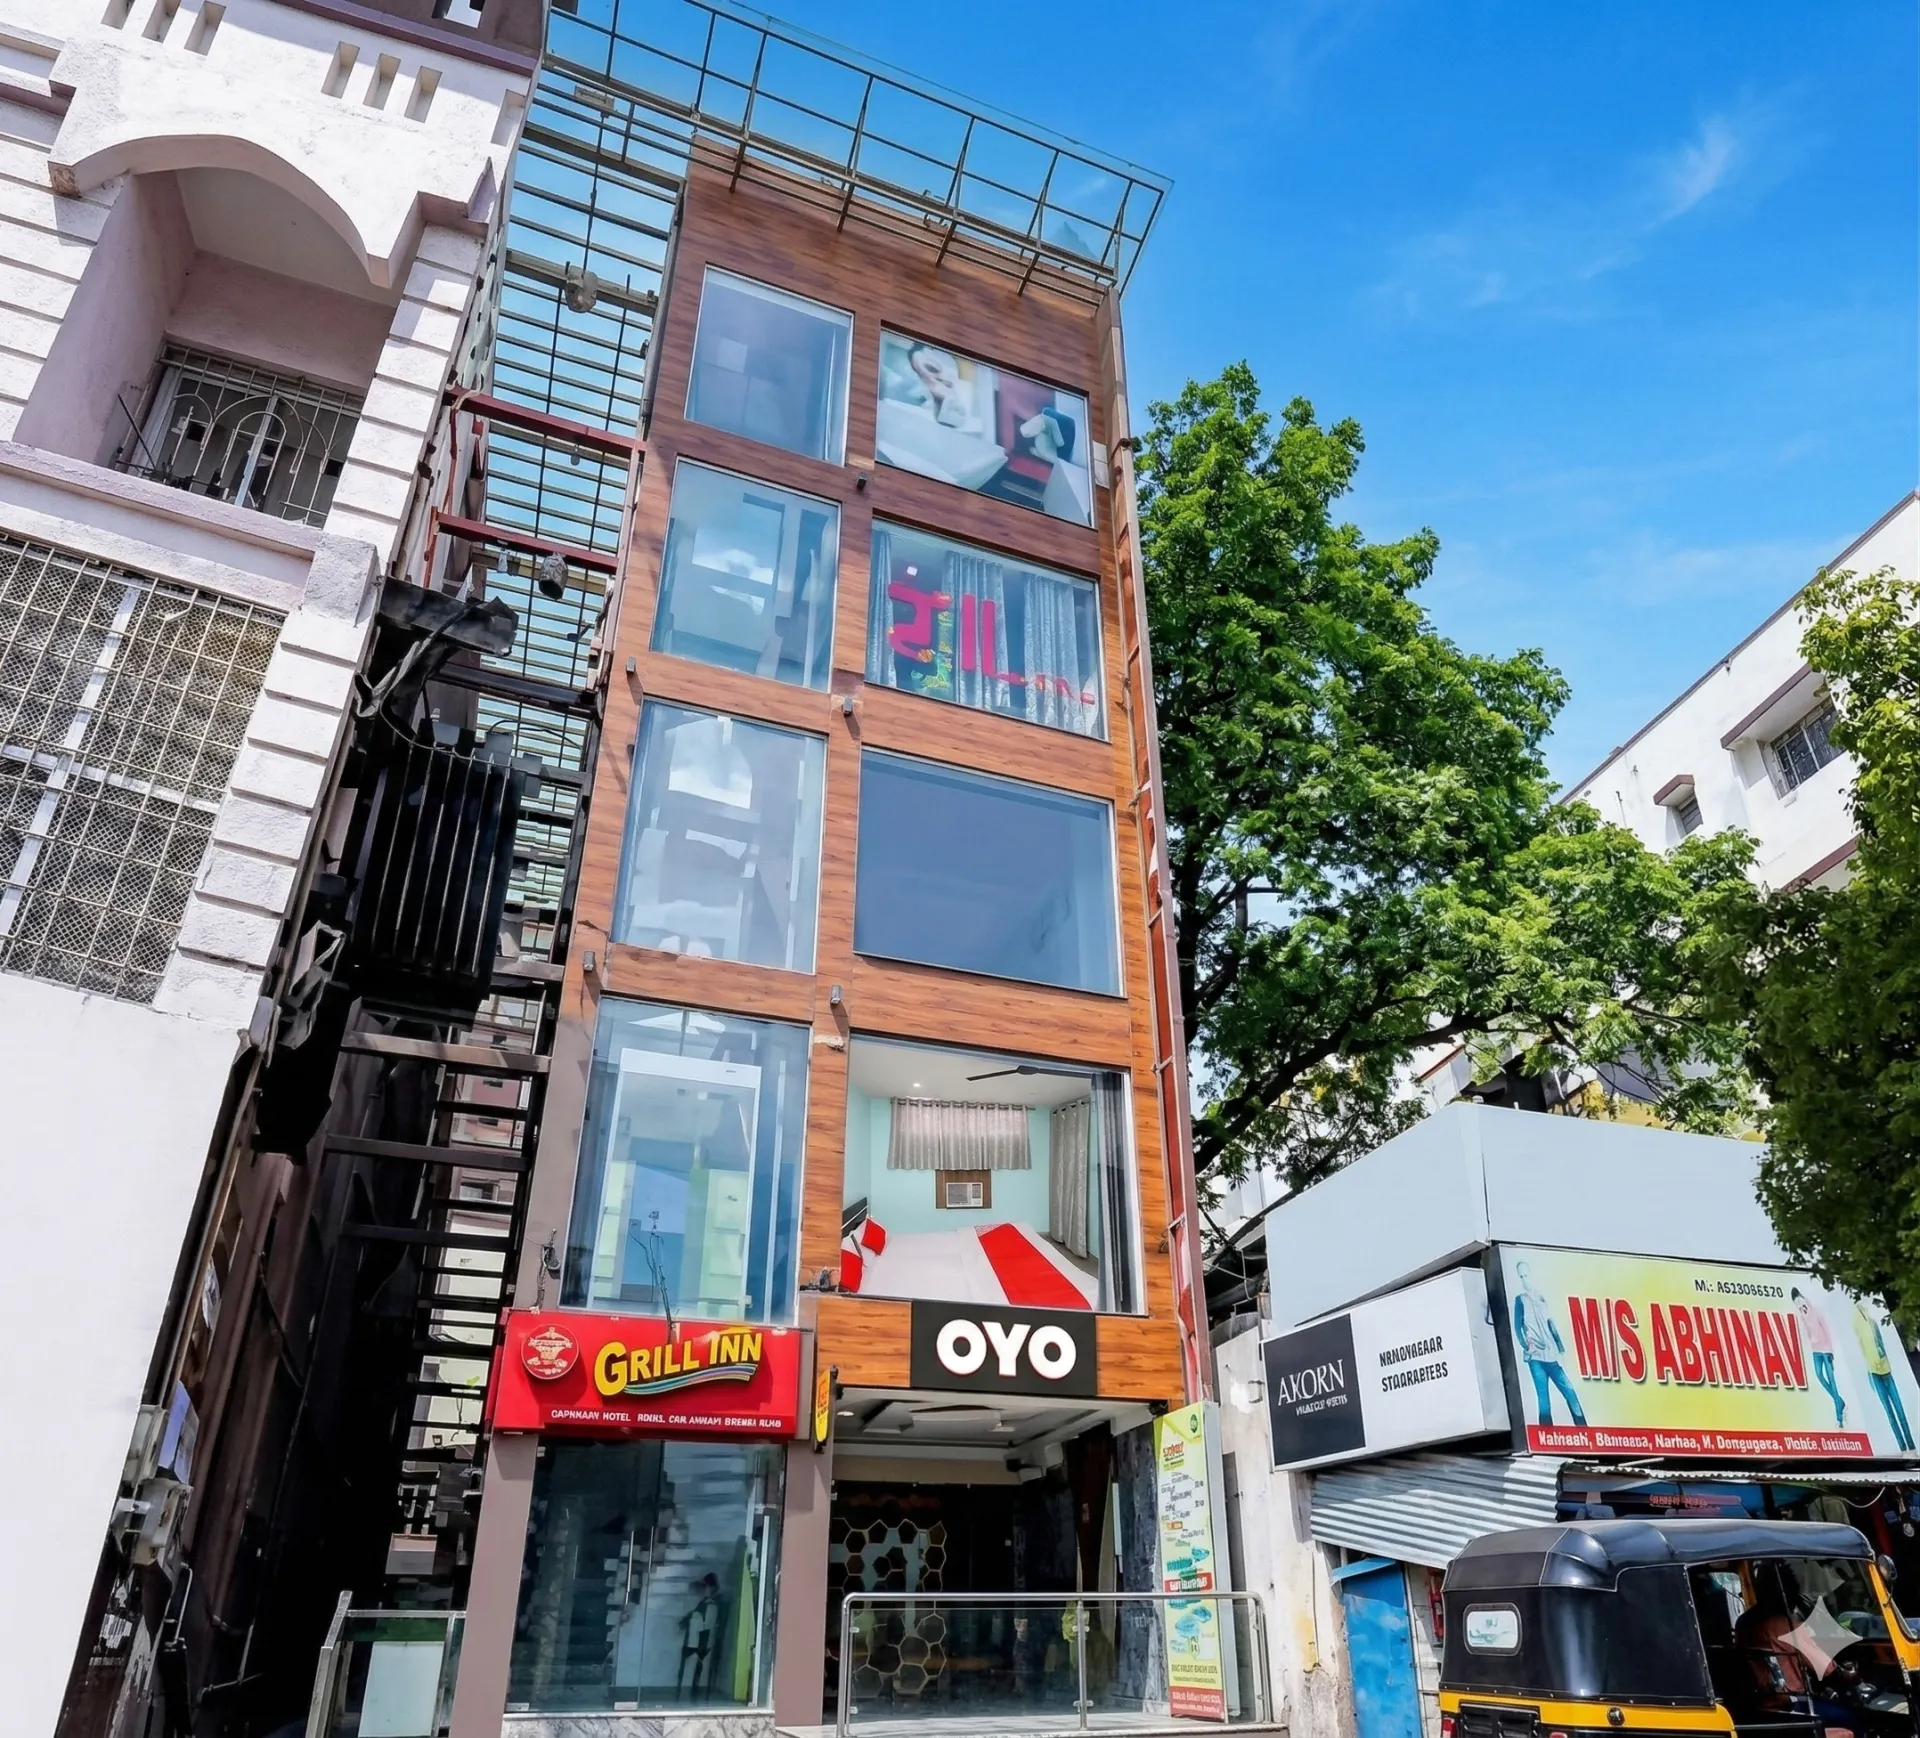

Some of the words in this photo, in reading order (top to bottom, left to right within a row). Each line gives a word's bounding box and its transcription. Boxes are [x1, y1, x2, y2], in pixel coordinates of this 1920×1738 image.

[594, 1340, 700, 1396] GRILL
[709, 1332, 762, 1365] INN
[936, 1318, 1077, 1381] OYO
[1648, 1302, 1809, 1390] ABHINAV
[1277, 1358, 1345, 1406] AKORN
[602, 1411, 632, 1422] HOTEL
